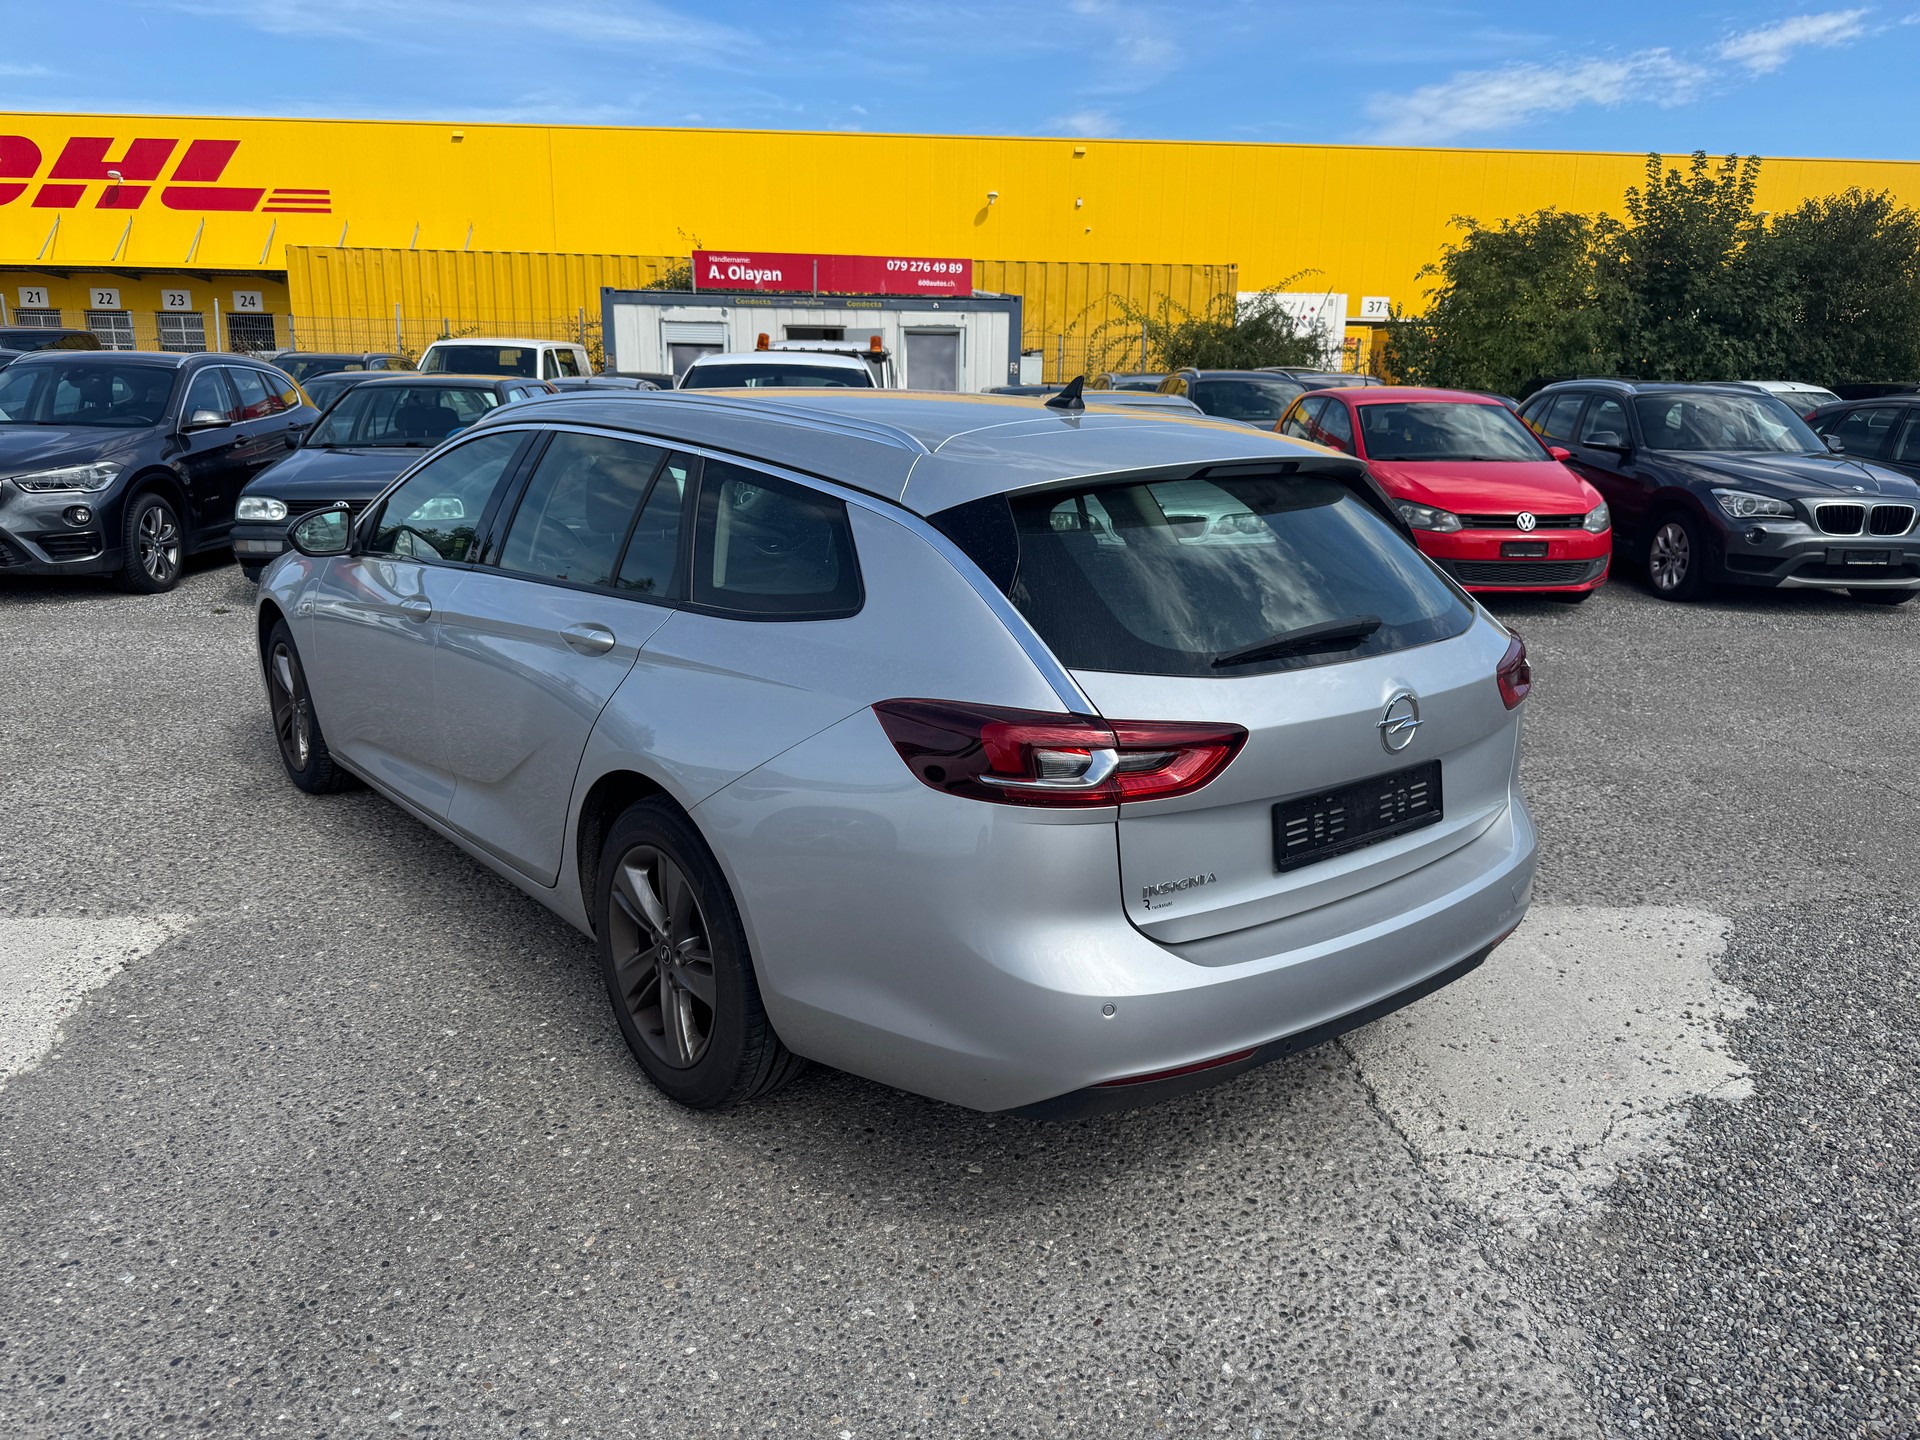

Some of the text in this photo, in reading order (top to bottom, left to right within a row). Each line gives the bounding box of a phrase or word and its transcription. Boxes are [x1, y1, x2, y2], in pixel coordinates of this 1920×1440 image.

[708, 255, 751, 264] Händlername:
[886, 260, 963, 274] 079 276 49 89
[708, 265, 782, 284] A. Olayan
[917, 279, 956, 287] 600autos.ch
[27, 291, 42, 304] 21
[97, 292, 114, 305] 22
[169, 294, 185, 306] 23
[240, 295, 257, 308] 24
[846, 300, 882, 308] Condecta
[1142, 872, 1217, 898] INSIGNIA
